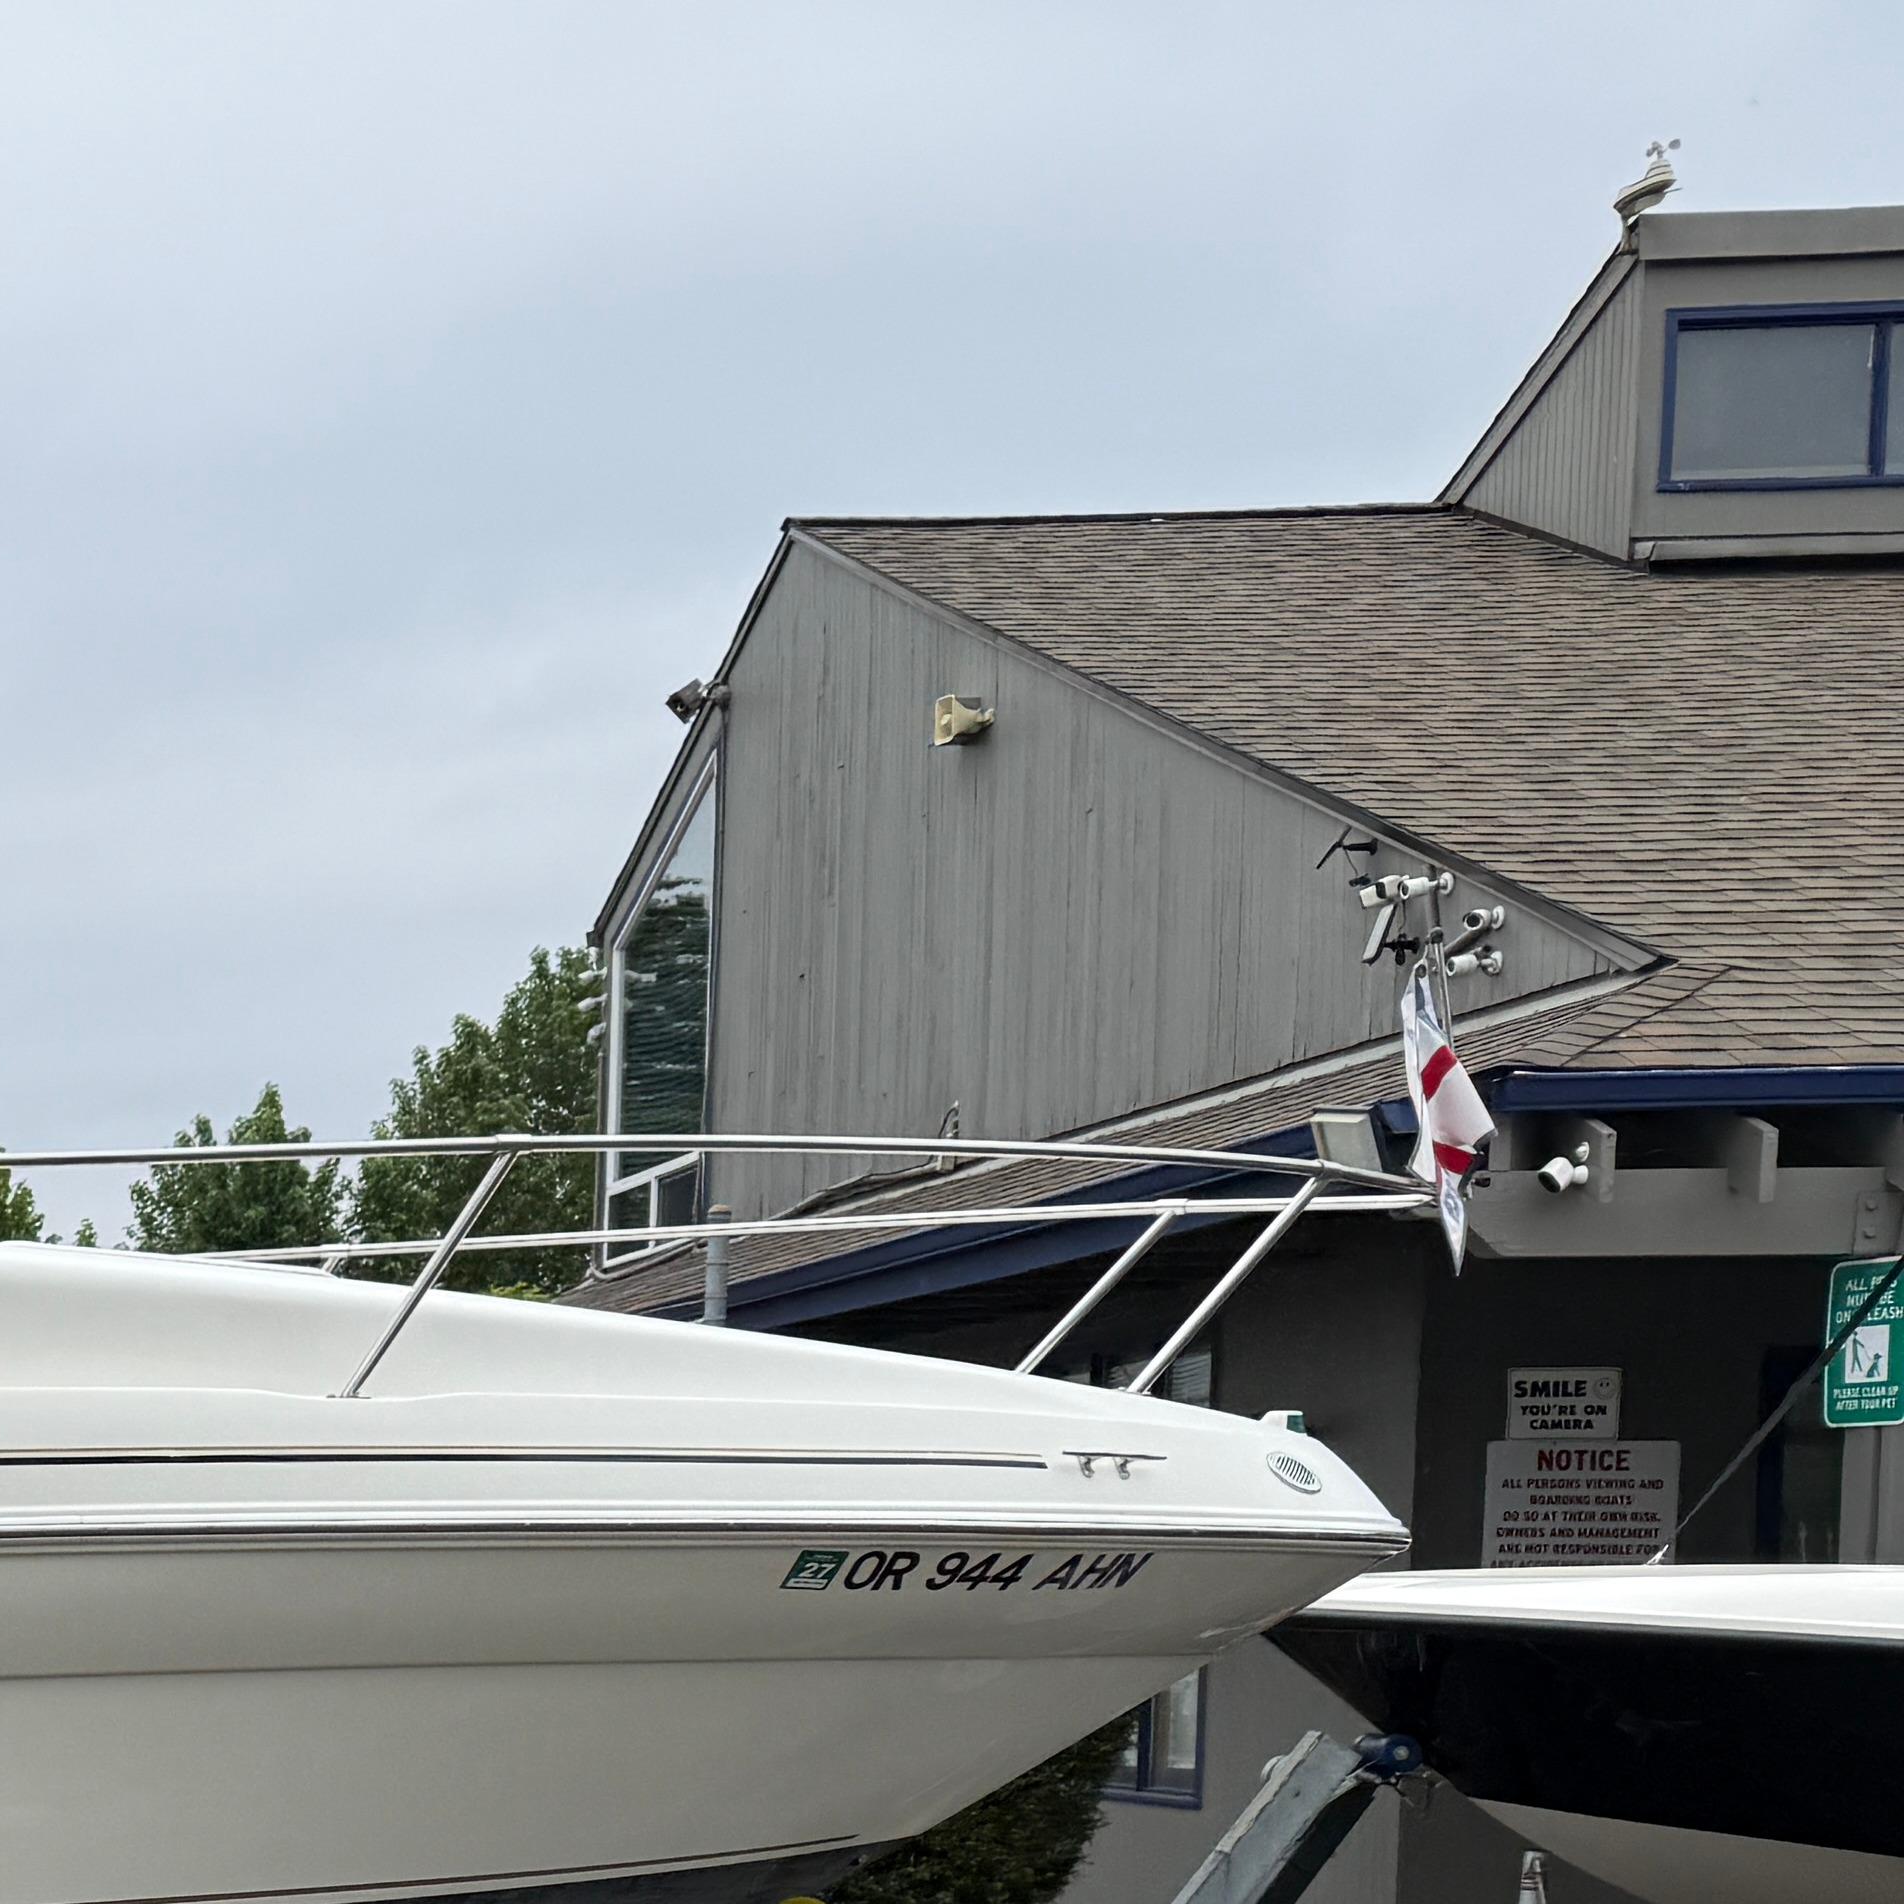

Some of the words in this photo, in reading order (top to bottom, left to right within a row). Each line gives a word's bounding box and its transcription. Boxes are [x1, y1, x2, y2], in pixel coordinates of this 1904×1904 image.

[1845, 1278, 1868, 1291] ALL
[1836, 1311, 1852, 1323] ON
[1513, 1380, 1587, 1398] SMILE
[1833, 1387, 1861, 1399] PLEASE
[1862, 1386, 1886, 1397] CLEAN
[1520, 1403, 1577, 1416] YOU'RE
[1583, 1404, 1607, 1416] ON
[1530, 1419, 1594, 1430] CAMERA
[1537, 1449, 1631, 1471] NOTICE
[1502, 1478, 1522, 1489] ALL
[1527, 1478, 1581, 1489] PERSONS
[1586, 1478, 1635, 1489] VIEWING
[1639, 1479, 1664, 1489] AND
[1503, 1511, 1519, 1521] DO
[1524, 1511, 1539, 1521] SO
[1543, 1511, 1558, 1521] AT
[1562, 1511, 1596, 1521] THEIR
[1496, 1527, 1545, 1538] OWNERS
[1550, 1527, 1574, 1538] AND
[1578, 1527, 1659, 1538] MANAGEMENT
[1499, 1544, 1521, 1554] ARE
[1525, 1544, 1549, 1554] NOT
[1553, 1544, 1633, 1555] RESPONSIBLE
[799, 1562, 837, 1578] 27
[844, 1550, 920, 1590] OR
[925, 1551, 1034, 1590] 944
[1032, 1552, 1154, 1590] AHN
